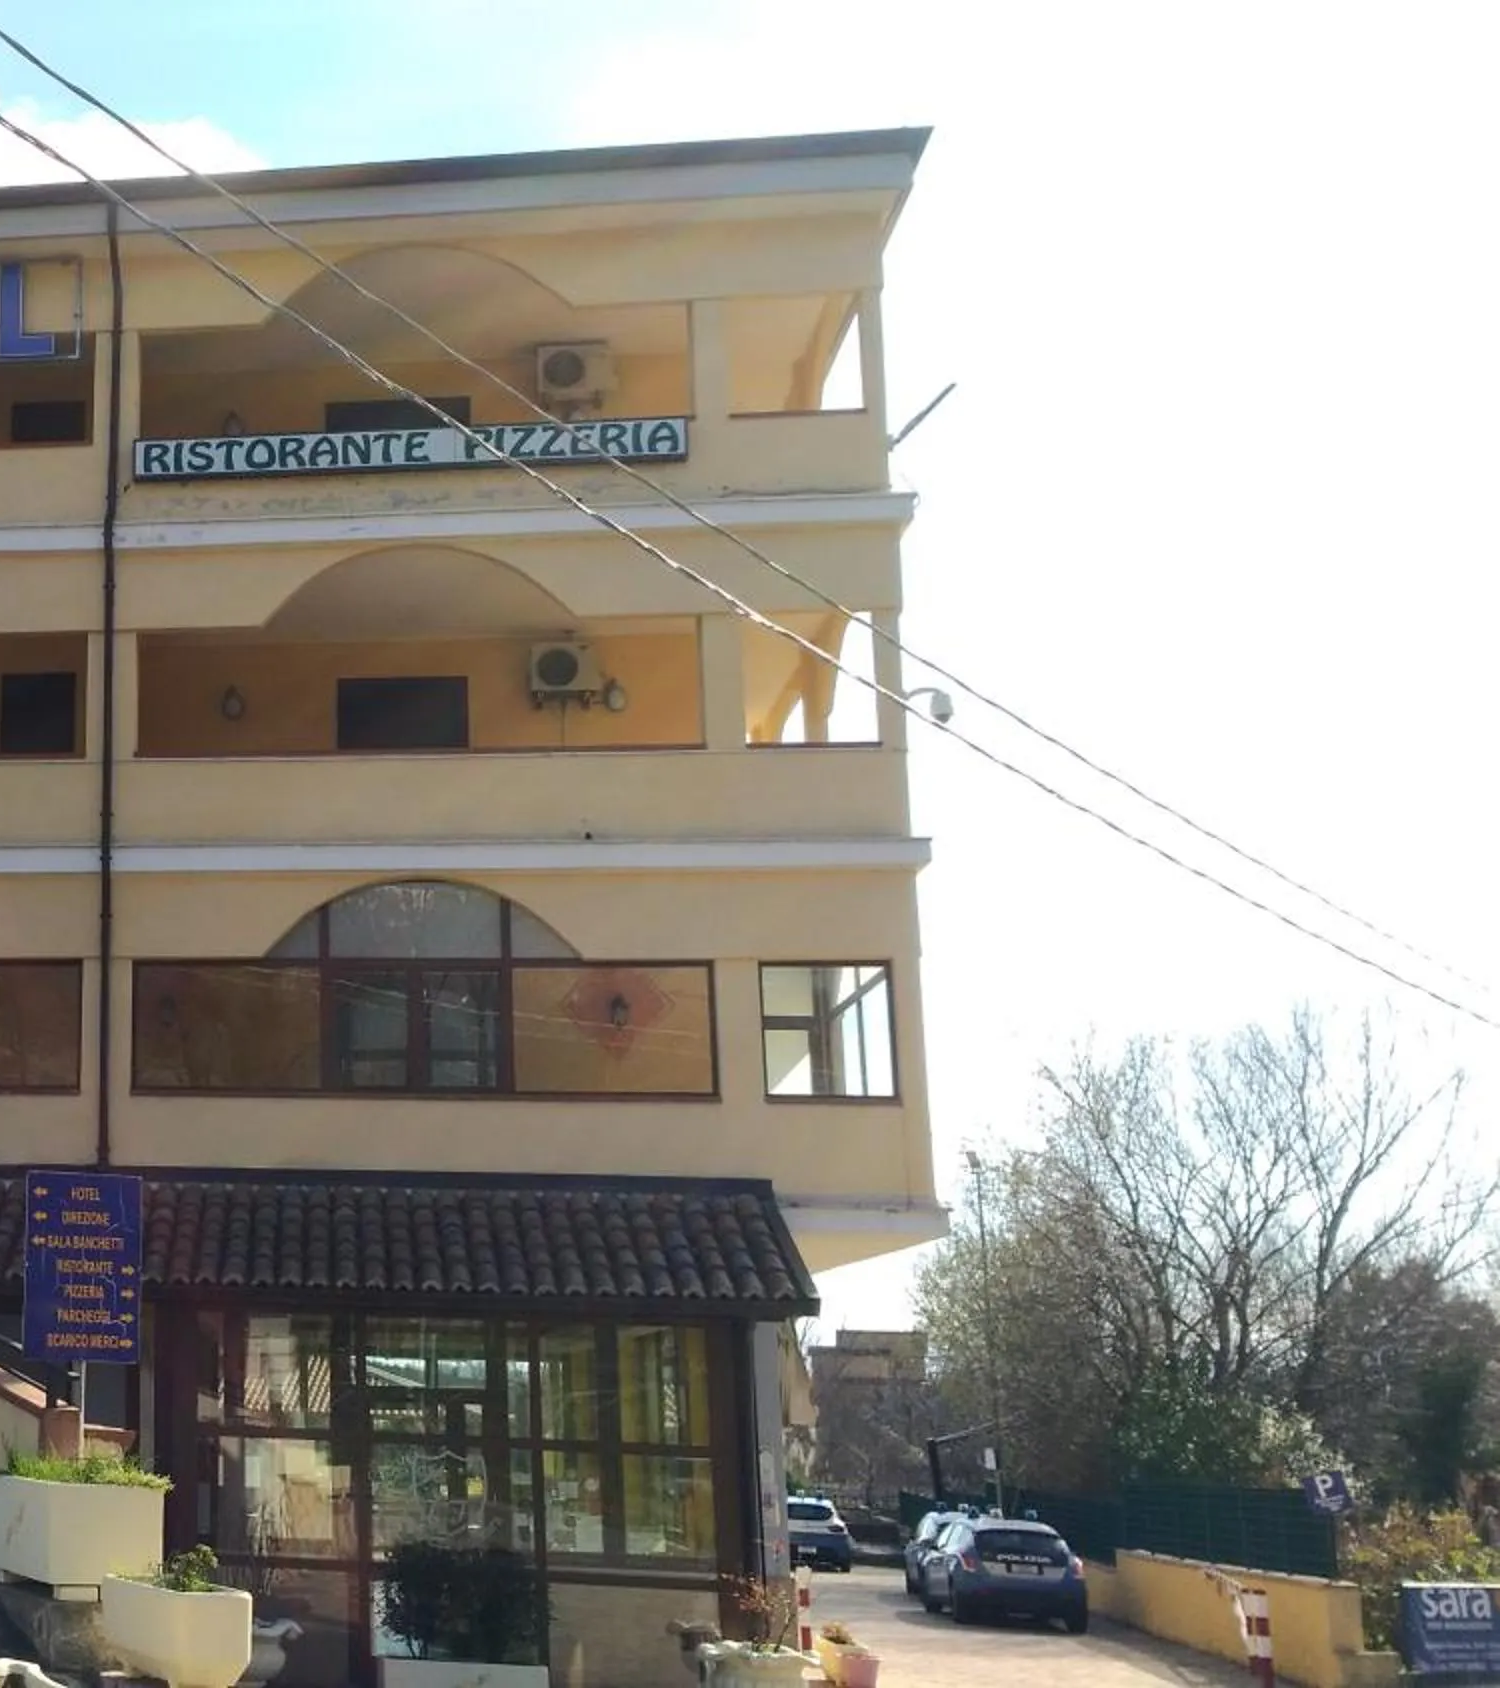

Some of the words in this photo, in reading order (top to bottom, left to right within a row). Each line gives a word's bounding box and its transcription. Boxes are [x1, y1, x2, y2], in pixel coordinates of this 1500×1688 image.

[143, 431, 431, 473] RISTORANTE
[464, 421, 681, 460] PIZZERIA
[71, 1187, 101, 1201] HOTEL
[47, 1235, 71, 1248] SALA
[56, 1259, 114, 1274] RISTORANTE
[64, 1284, 105, 1299] PIZZERIA
[1315, 1475, 1333, 1498] P
[996, 1553, 1053, 1564] POLIZIA
[1421, 1588, 1492, 1619] sara
